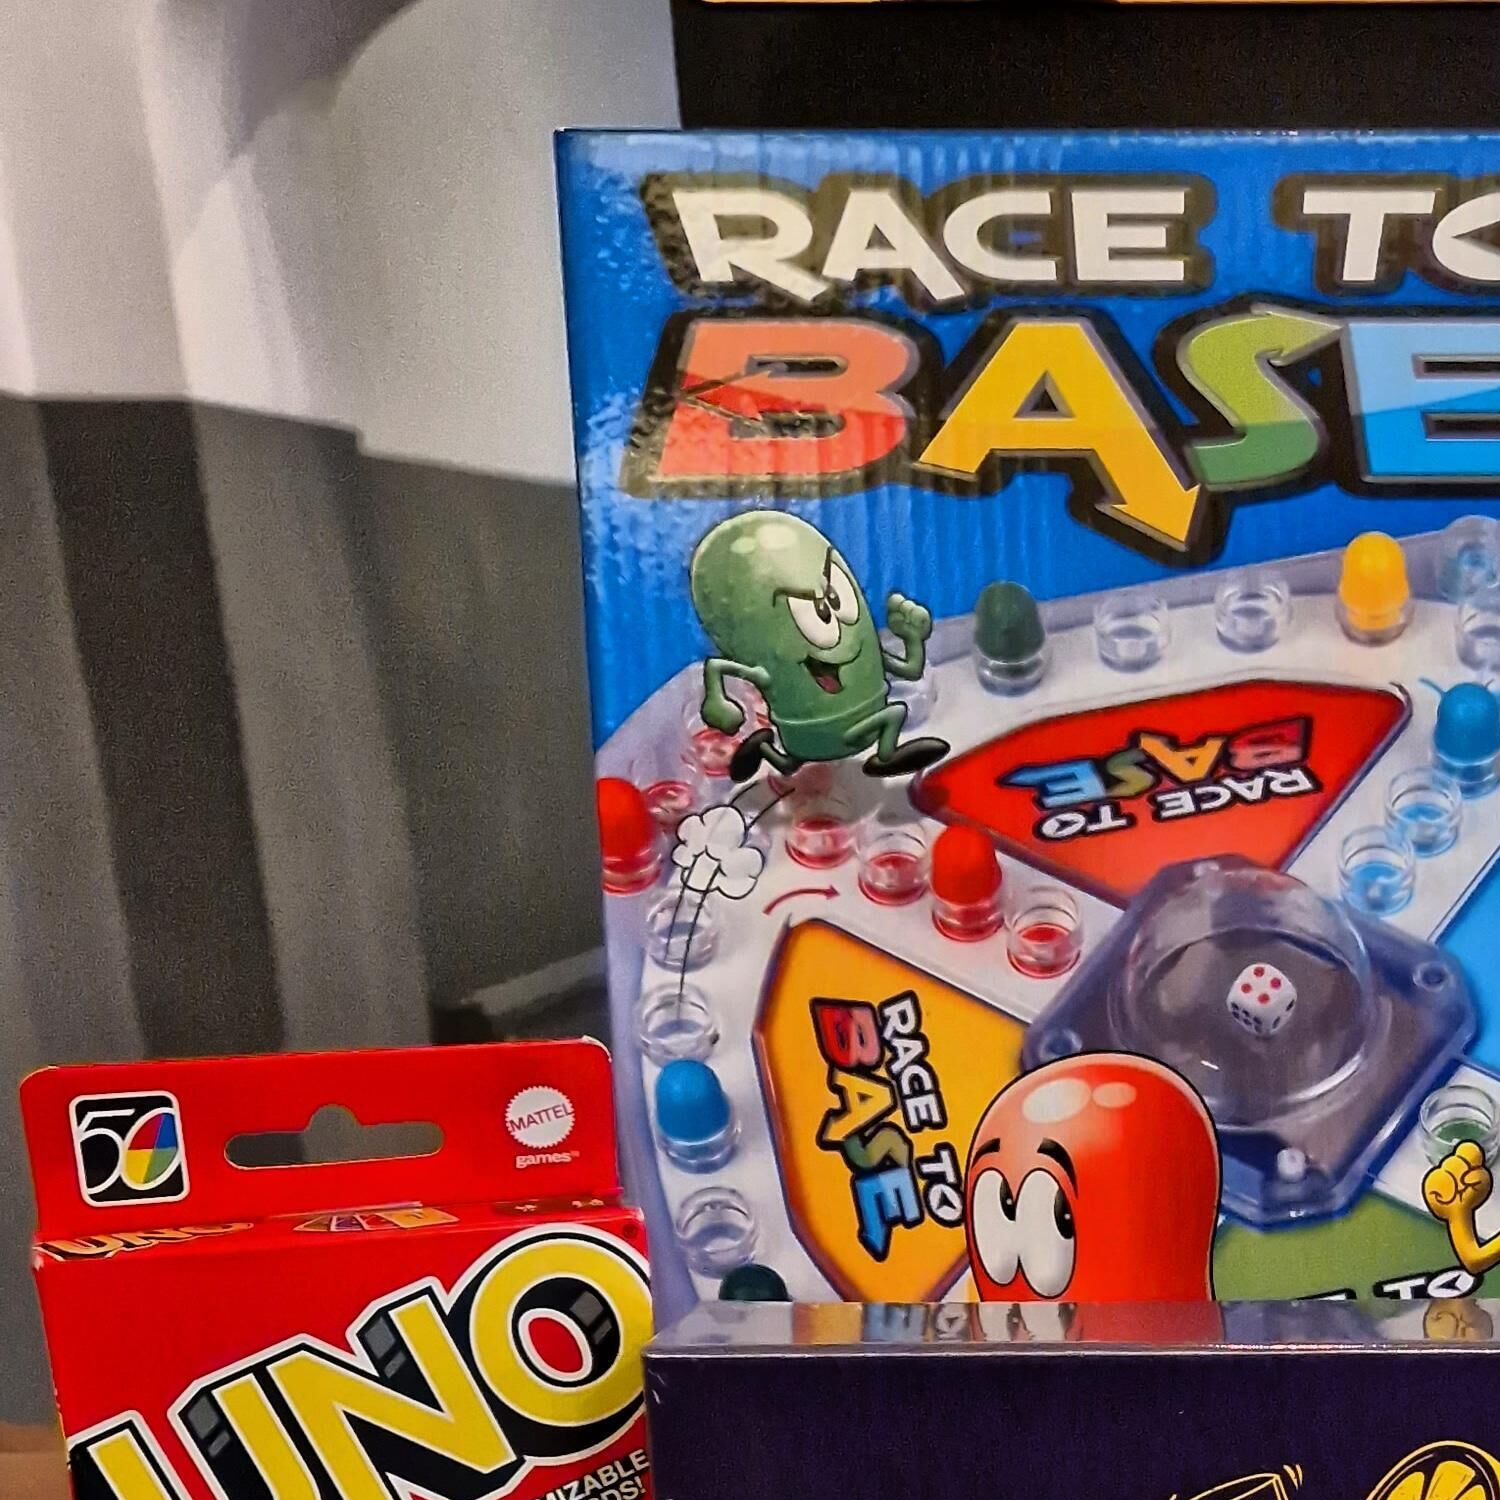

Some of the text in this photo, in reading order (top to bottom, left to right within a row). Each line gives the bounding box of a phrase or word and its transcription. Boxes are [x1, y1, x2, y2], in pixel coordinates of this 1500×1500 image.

[668, 184, 1190, 302] RACE
[1004, 717, 1312, 808] BASE
[1038, 767, 1319, 840] RACE TO
[509, 1103, 575, 1132] MATTEL
[813, 999, 923, 1258] BASE
[881, 994, 964, 1223] RACE TO
